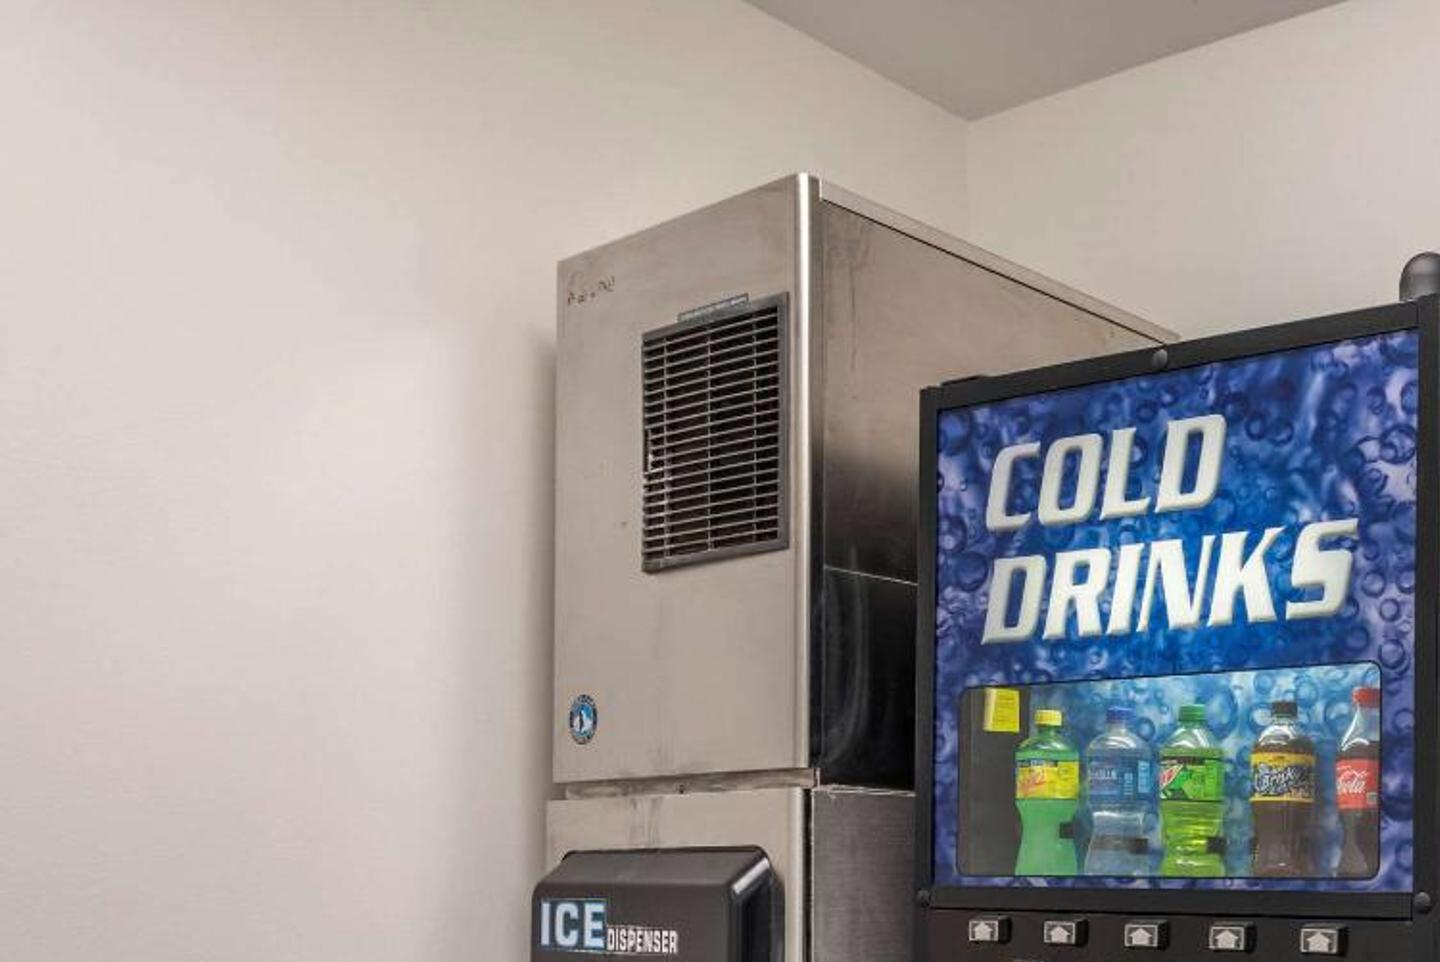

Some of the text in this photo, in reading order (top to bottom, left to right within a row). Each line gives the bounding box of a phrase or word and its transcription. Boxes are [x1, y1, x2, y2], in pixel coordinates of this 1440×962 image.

[985, 413, 1228, 533] COLD
[981, 516, 1360, 646] DRINKS
[540, 902, 679, 954] ICE DISPENSER
